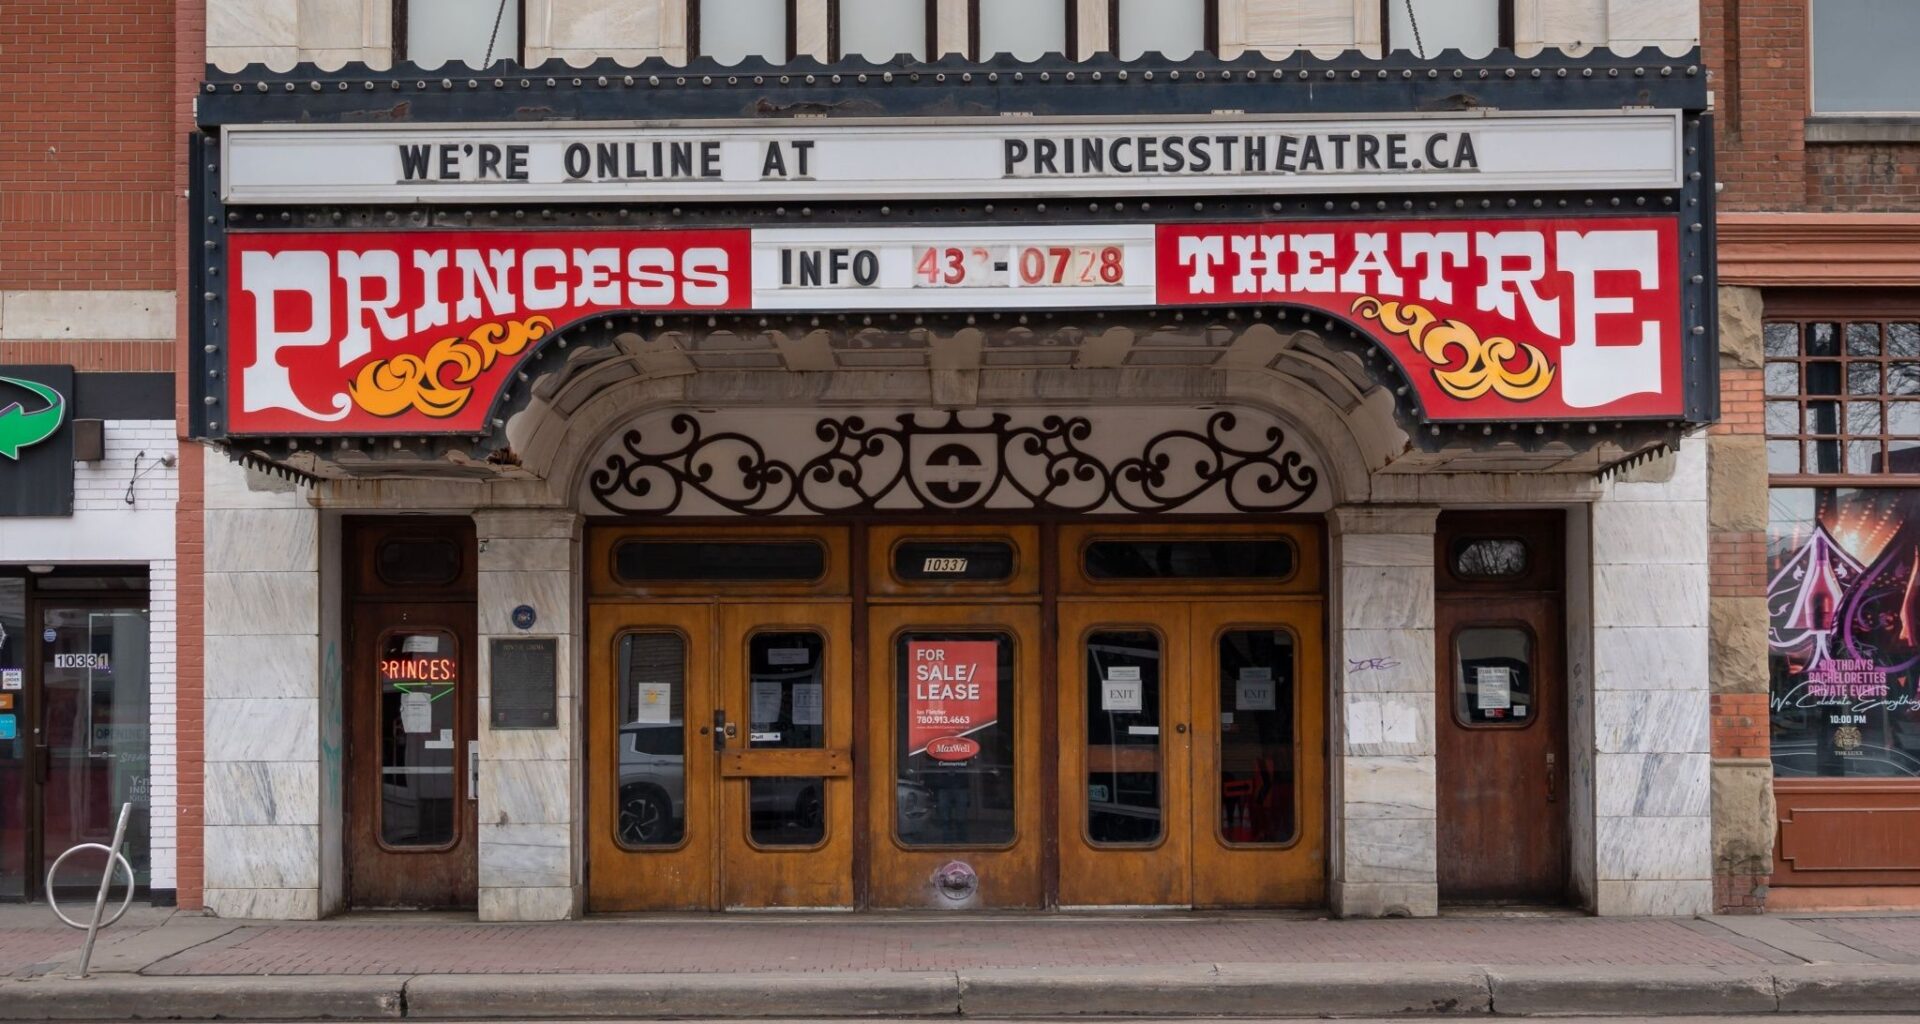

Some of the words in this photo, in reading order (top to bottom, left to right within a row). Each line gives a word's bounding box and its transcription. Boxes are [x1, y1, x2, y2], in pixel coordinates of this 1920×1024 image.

[399, 143, 530, 181] WE'RE
[564, 141, 722, 179] ONLINE
[761, 140, 815, 177] AT
[1004, 132, 1479, 174] PRINCESSTHEATRE.CA
[781, 247, 880, 287] INFO
[1178, 229, 1662, 408] THEATRE
[241, 246, 729, 421] PRINCESS
[924, 558, 967, 572] 10337
[917, 649, 944, 660] FOR
[57, 655, 108, 667] 10331
[1820, 659, 1873, 671] BIRTHDAYS
[917, 664, 976, 682] SALE/
[1808, 672, 1886, 683] BACHELORETTES
[917, 684, 979, 700] LEASE
[1109, 689, 1135, 699] EXIT
[1243, 689, 1268, 699] EXIT
[1808, 685, 1847, 696] PRIVATE
[1850, 685, 1888, 696] EVENTS
[1770, 690, 1792, 712] We
[1795, 682, 1852, 708] Celebrate
[916, 716, 970, 724] 780.913.4663
[1830, 715, 1852, 724] 10:00
[1854, 715, 1867, 724] PM
[936, 744, 971, 753] MaxWell
